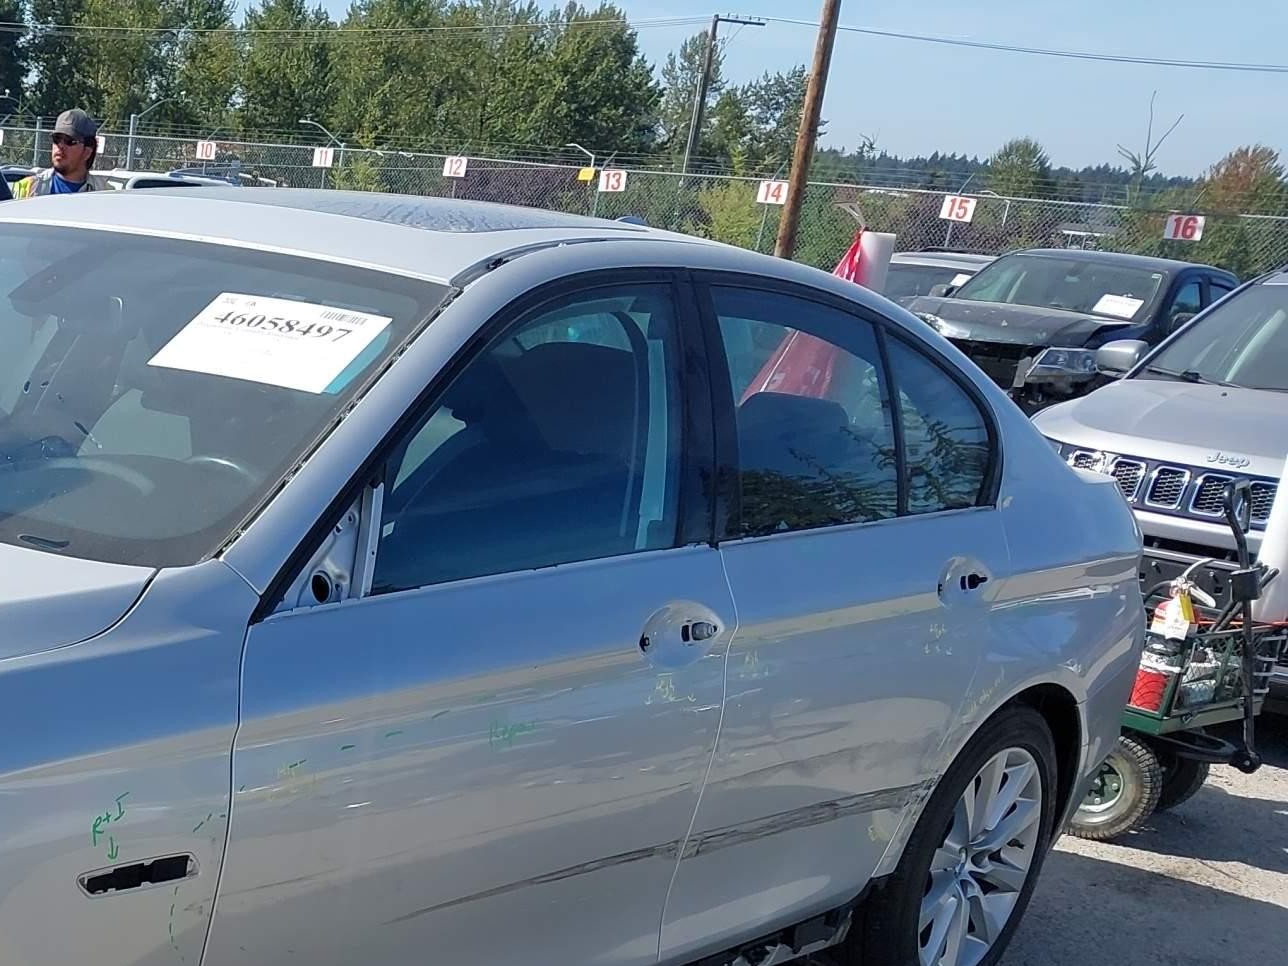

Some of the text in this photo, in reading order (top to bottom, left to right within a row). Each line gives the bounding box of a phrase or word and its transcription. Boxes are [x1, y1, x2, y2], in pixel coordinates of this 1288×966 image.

[201, 143, 212, 158] 10
[319, 150, 328, 165] 11
[449, 159, 462, 175] 12
[605, 172, 621, 190] 13
[764, 183, 782, 201] 14
[948, 198, 970, 219] 15
[1172, 217, 1199, 239] 16
[214, 311, 352, 342] 46058497
[1207, 451, 1251, 469] Jeep
